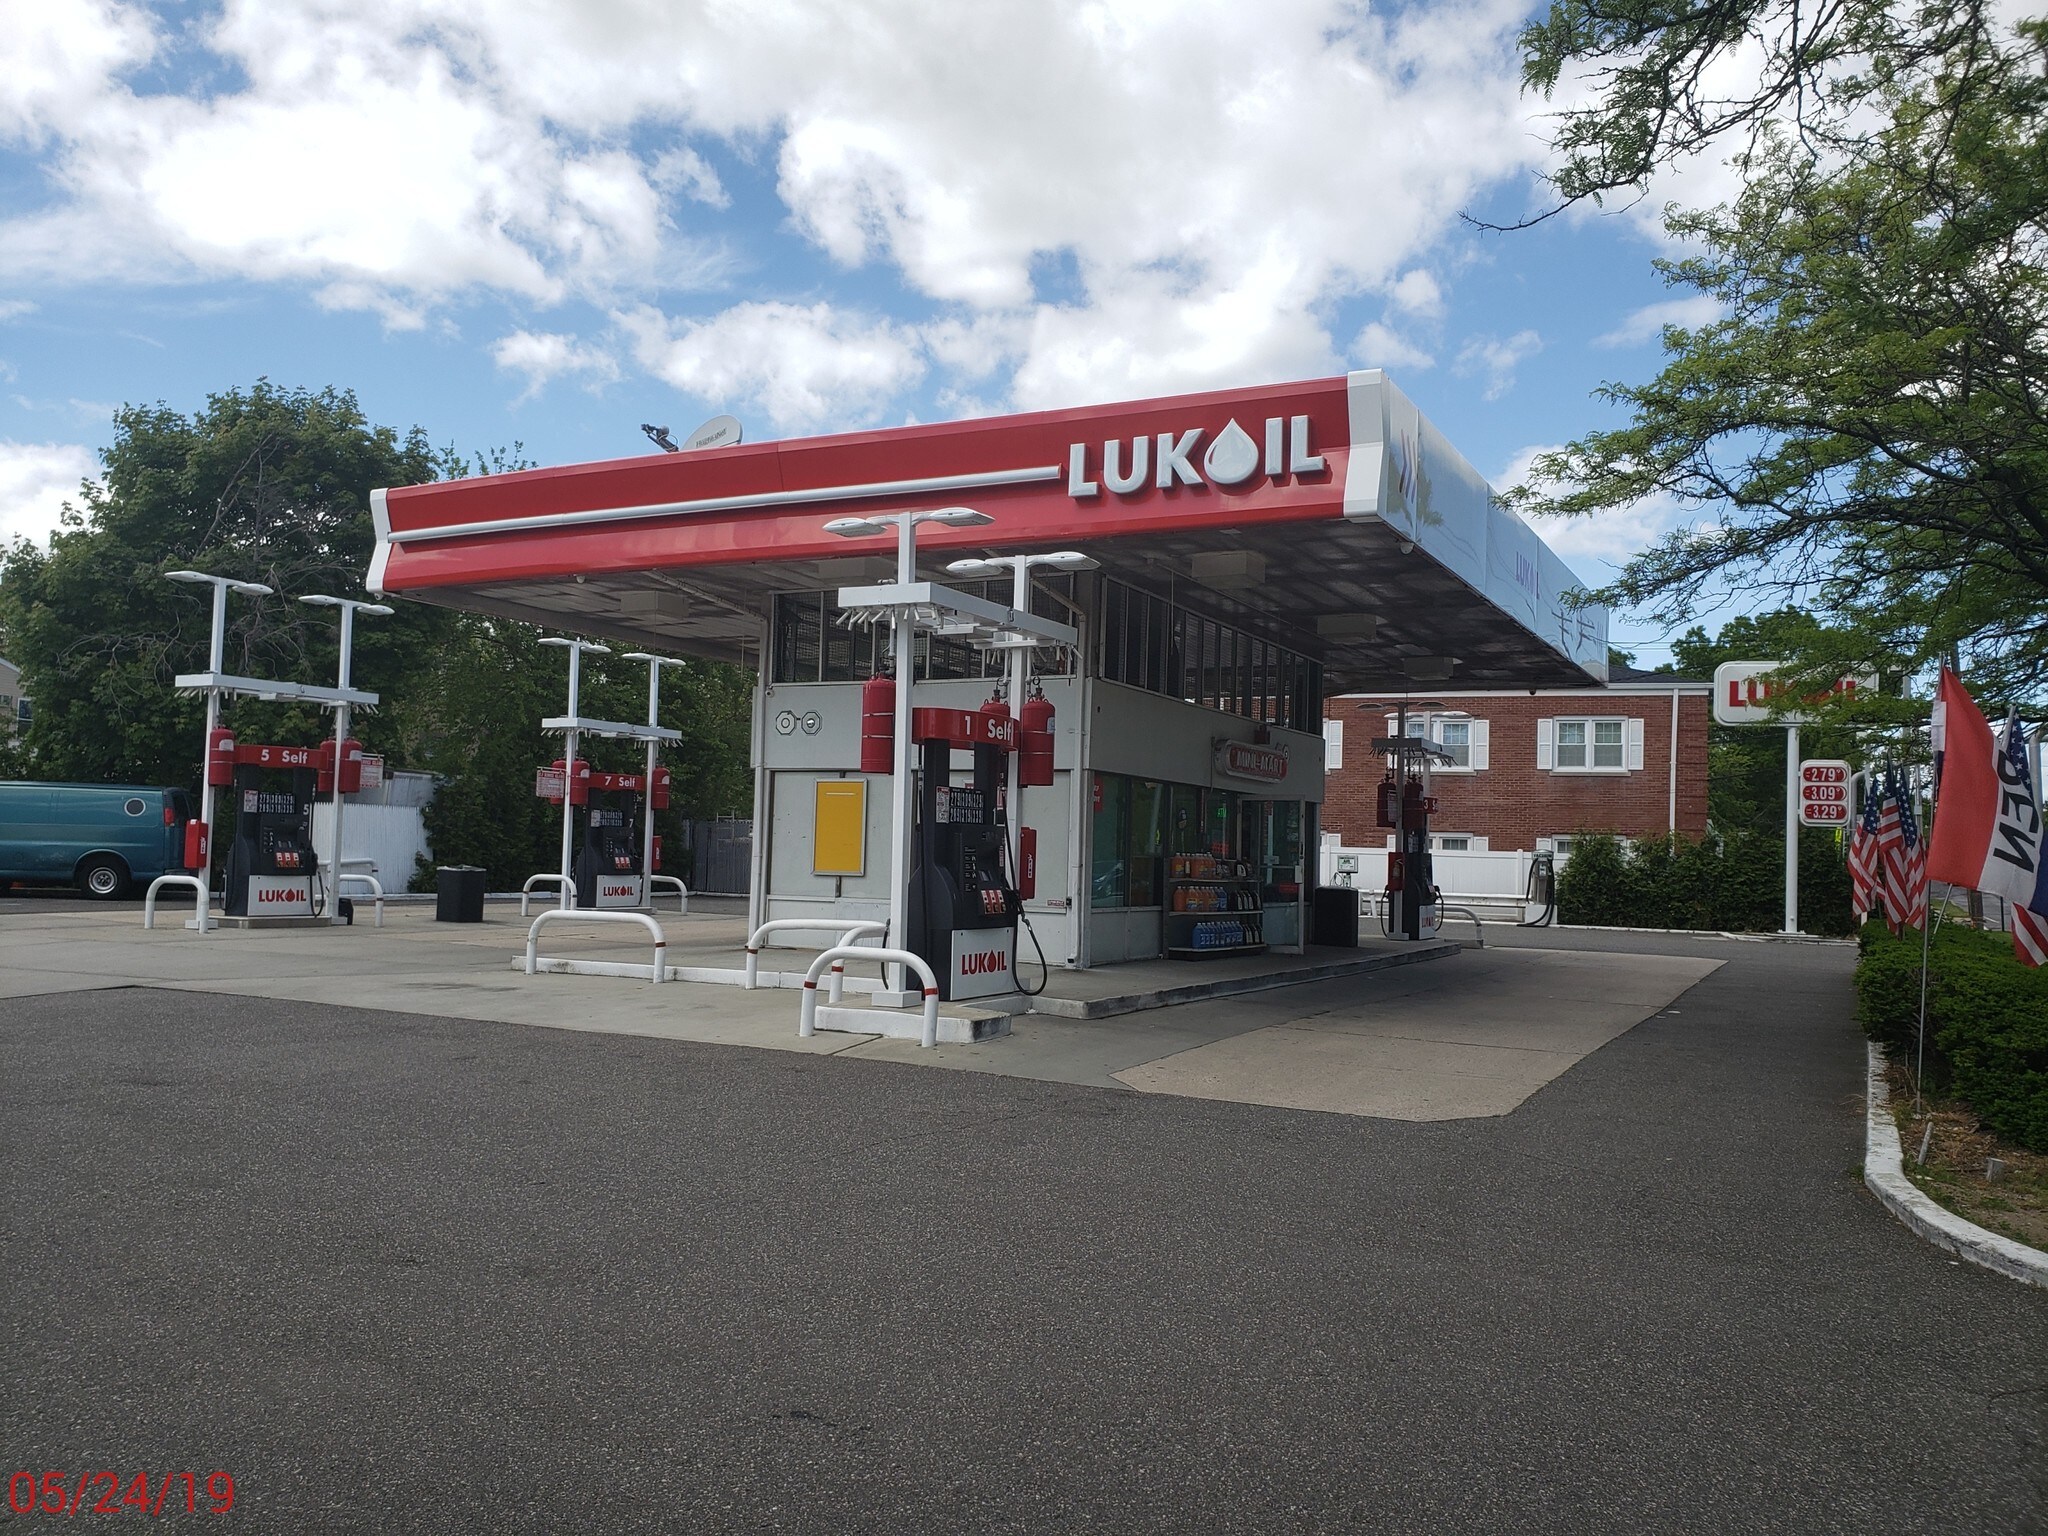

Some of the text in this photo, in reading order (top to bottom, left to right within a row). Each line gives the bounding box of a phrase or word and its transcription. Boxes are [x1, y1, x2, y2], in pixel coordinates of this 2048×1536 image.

[1068, 415, 1325, 496] LUKOIL
[964, 716, 1012, 740] 1 Self
[261, 749, 308, 764] 5 Self
[604, 776, 636, 788] 7 Self
[303, 804, 309, 815] 5
[629, 818, 634, 828] 7
[258, 888, 307, 902] LUKOIL
[603, 885, 634, 897] LUKOIL
[961, 950, 1007, 976] LUKOIL
